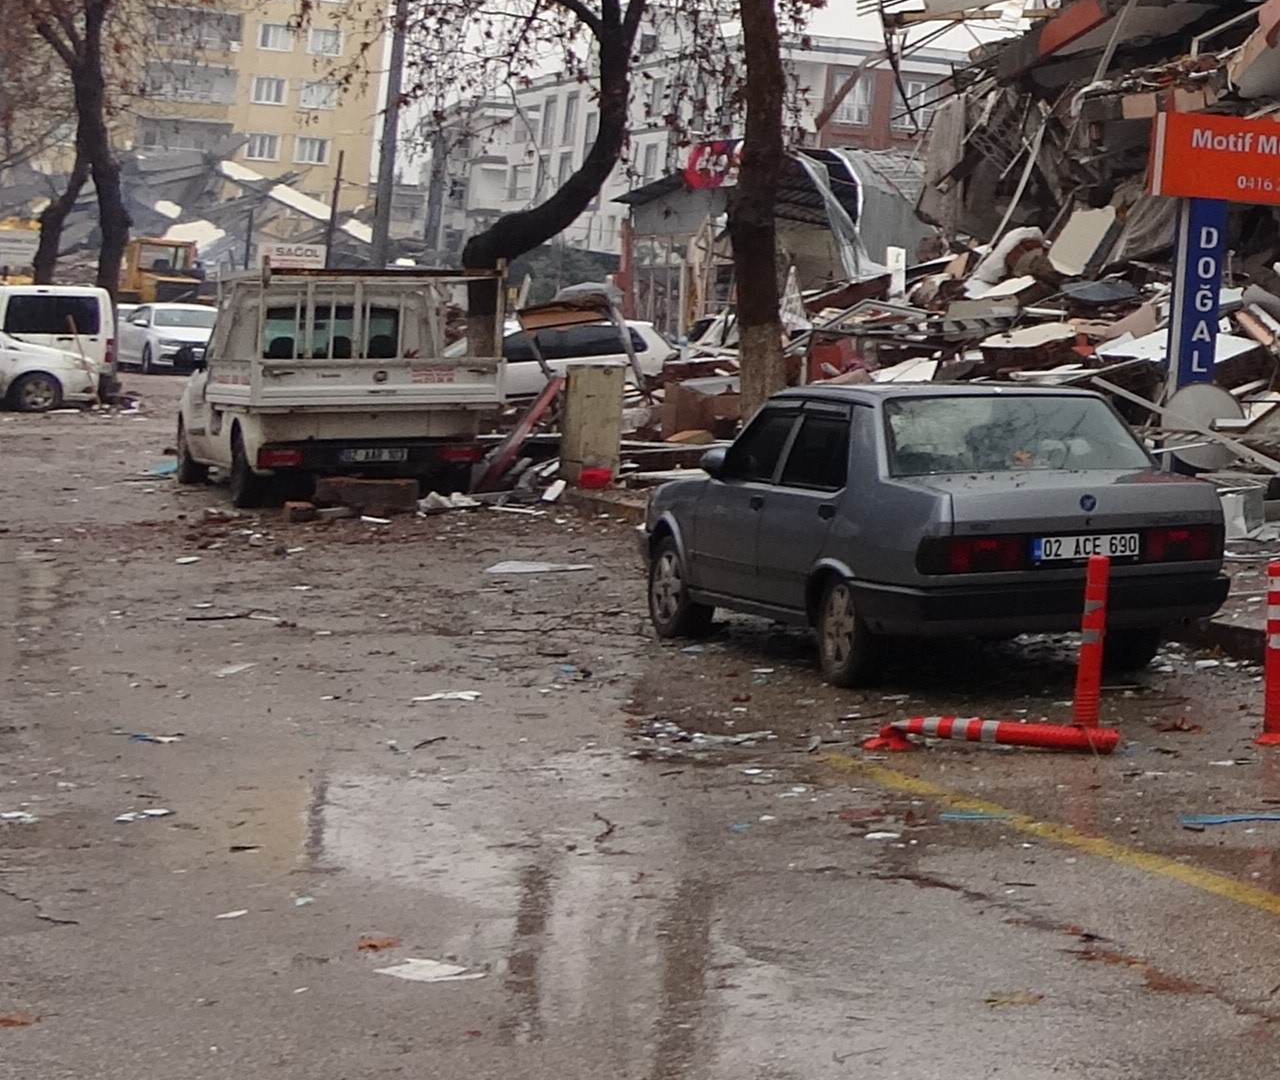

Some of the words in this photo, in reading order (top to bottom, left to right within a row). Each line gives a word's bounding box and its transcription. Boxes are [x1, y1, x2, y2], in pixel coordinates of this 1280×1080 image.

[1191, 128, 1254, 153] Motif
[1237, 175, 1273, 191] 0416
[1191, 226, 1219, 373] DOĞAL
[1043, 538, 1062, 558] 02
[1073, 537, 1101, 556] ACE
[1109, 535, 1137, 554] 690
